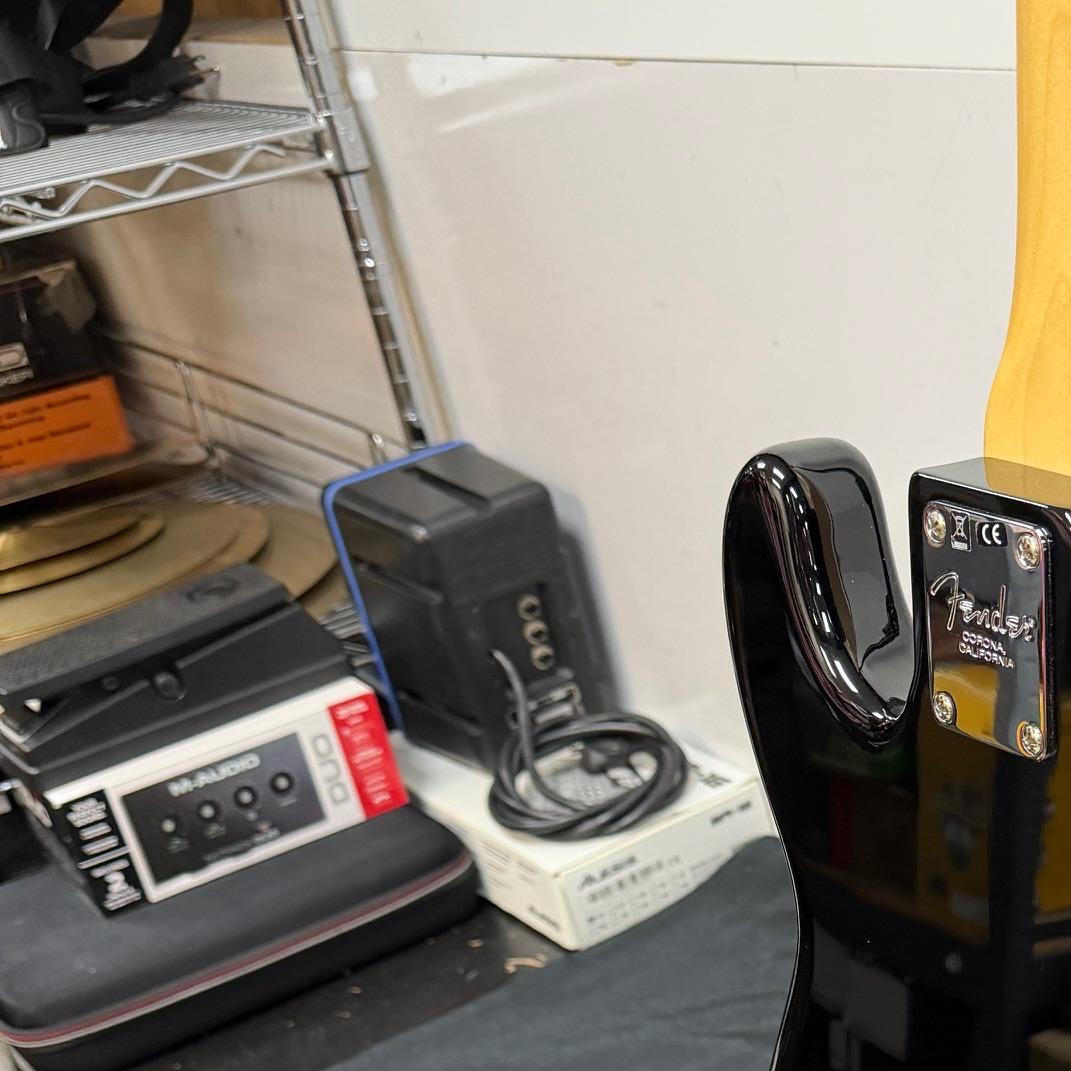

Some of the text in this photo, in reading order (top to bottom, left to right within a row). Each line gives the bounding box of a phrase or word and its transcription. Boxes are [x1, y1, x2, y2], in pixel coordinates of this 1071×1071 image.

[930, 572, 1035, 642] Fender
[958, 641, 1015, 669] CALIFORNIA
[962, 632, 1006, 655] CORONA,
[168, 754, 260, 797] M-AUDIO
